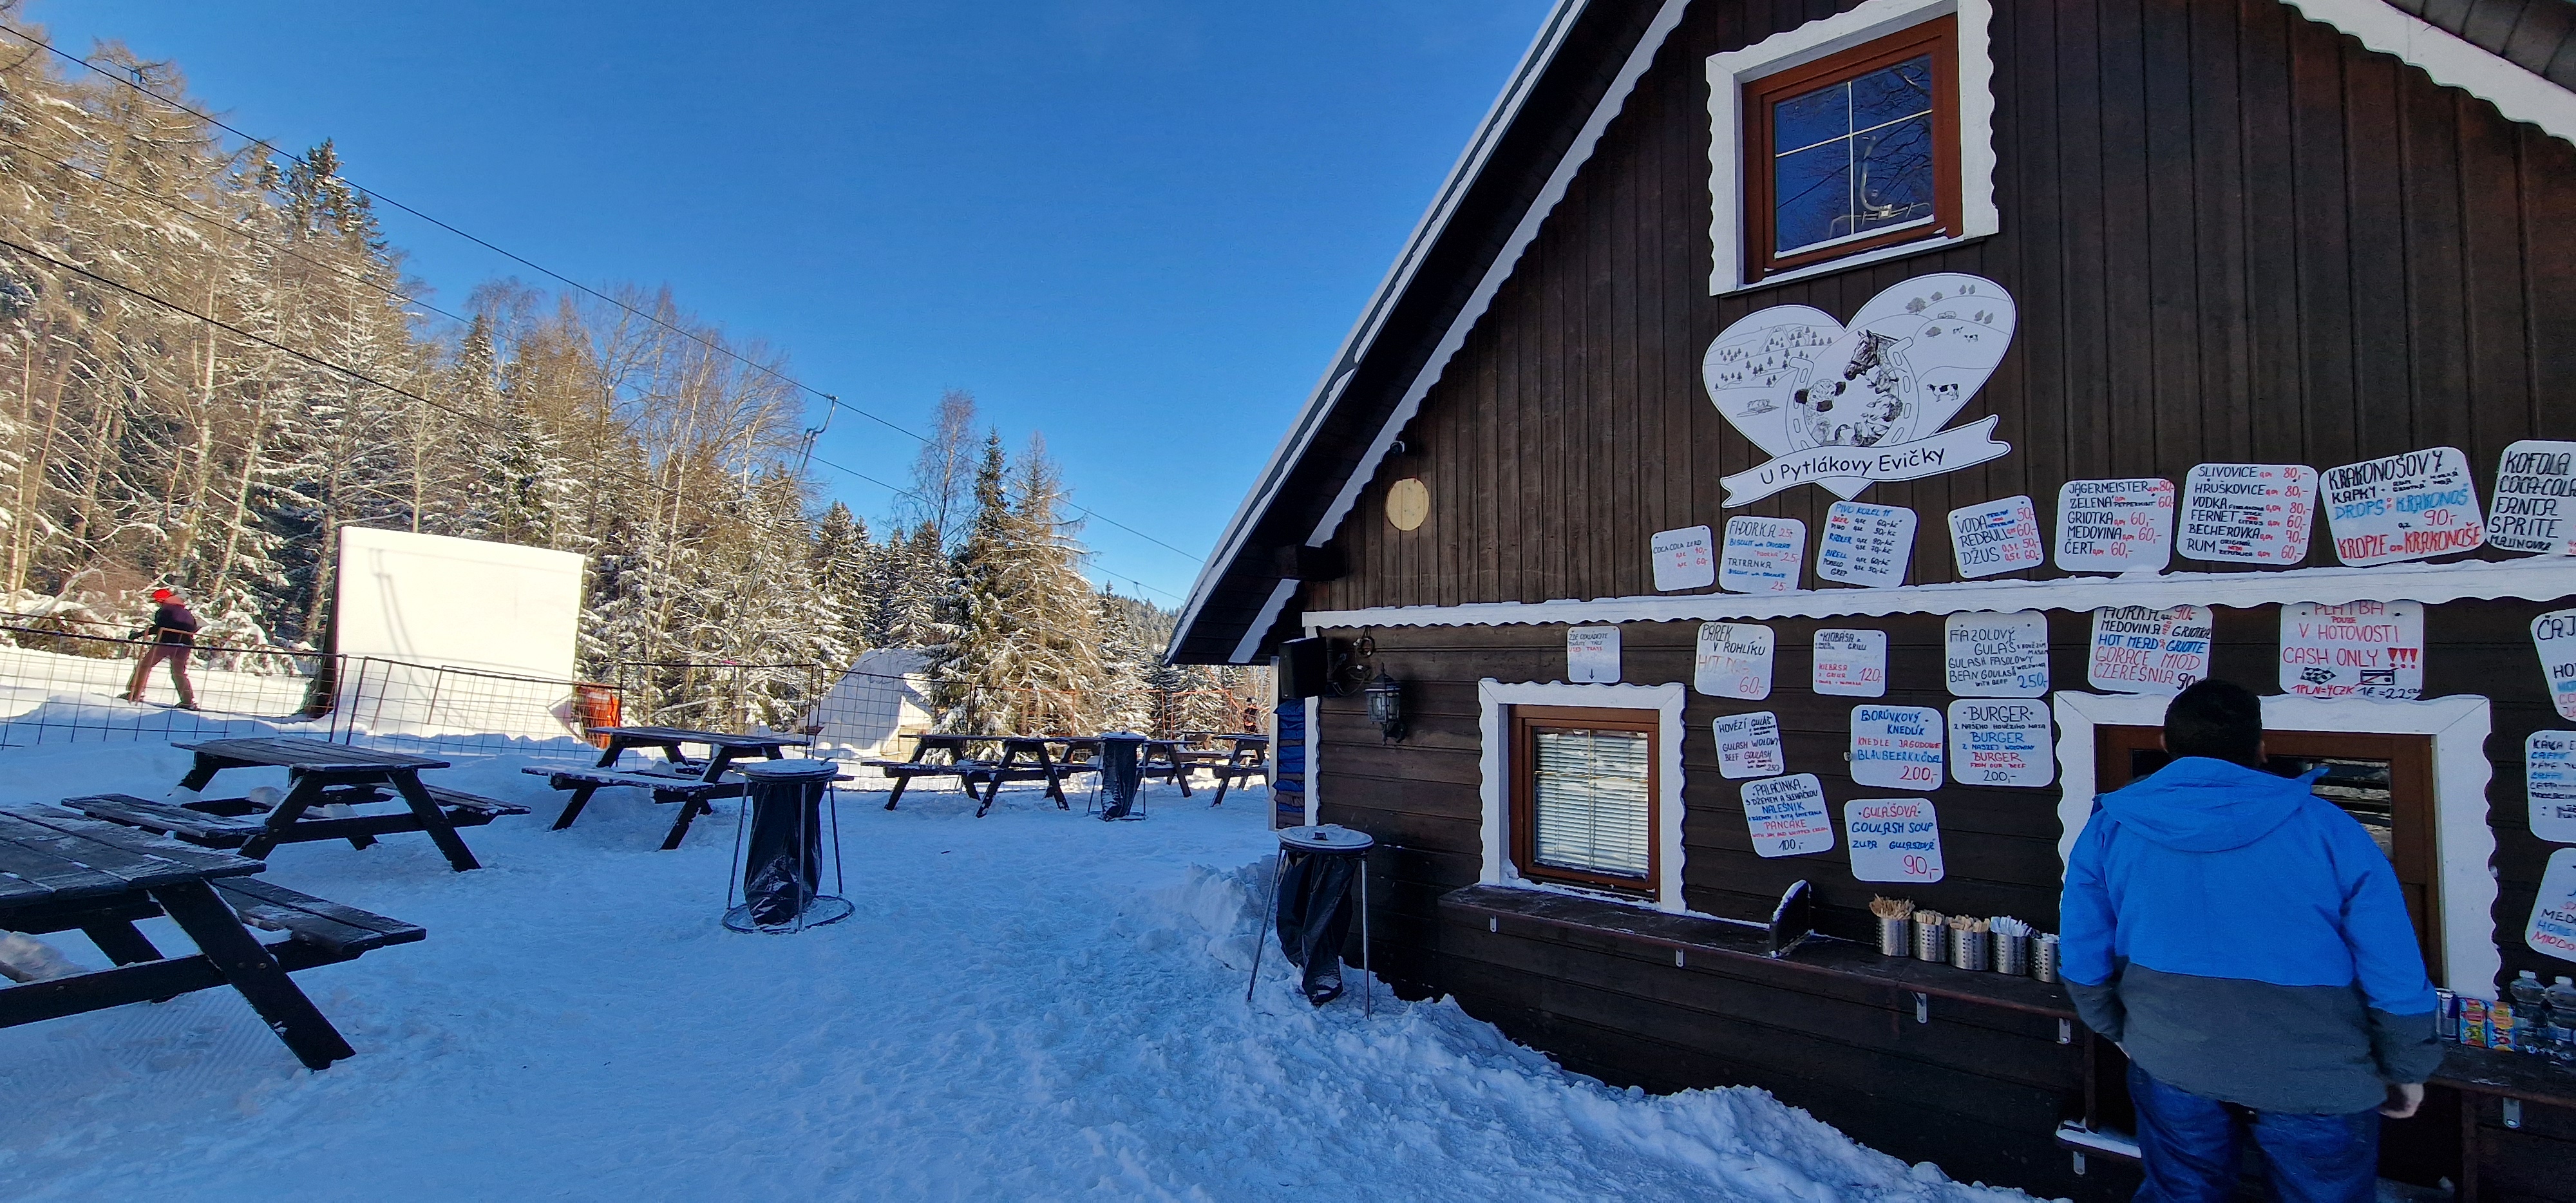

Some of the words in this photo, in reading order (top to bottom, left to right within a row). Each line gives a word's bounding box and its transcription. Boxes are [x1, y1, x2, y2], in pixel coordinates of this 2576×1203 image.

[1760, 469, 1774, 484] U
[1780, 455, 1873, 482] Pytlákovy
[1879, 448, 1945, 472] Evičky
[2505, 451, 2571, 475] KOFOLA
[2198, 466, 2258, 477] SLIVOVICE
[2069, 481, 2148, 494] JÄGERMEISTER
[2195, 480, 2266, 495] HRUŠKOVICE
[2070, 496, 2114, 509] ZELENÁ
[2332, 487, 2376, 504] KAPKY
[1836, 504, 1854, 514] PIVO
[1857, 507, 1880, 516] KOZEL
[2193, 497, 2228, 509] VODKA
[2334, 500, 2384, 520] DROPS
[2495, 497, 2558, 515] FANTA
[2067, 511, 2113, 525] GRIOTKA
[2191, 509, 2240, 522] FERNET
[1729, 520, 1776, 538] FIDORKA
[1956, 515, 1987, 533] VODA
[2490, 516, 2562, 538] SPRITE
[1958, 528, 2014, 547] REDBULL
[2067, 526, 2121, 540] MEDOVINA
[2188, 524, 2260, 539] BECHEROVKA
[2065, 539, 2094, 554] ČERT
[2186, 538, 2215, 553] RUM
[1962, 547, 2000, 565] DŽUS
[2101, 620, 2161, 635] MEDOVINA
[2299, 623, 2309, 638] V
[2318, 624, 2399, 643] HOTOVOSTI
[2098, 634, 2124, 646] HOT
[1714, 642, 1718, 652] V
[1723, 641, 1766, 656] ROHLÍKU
[1949, 657, 1985, 668] GULASH
[2283, 647, 2329, 664] CASH
[2336, 649, 2378, 667] ONLY
[1949, 670, 1978, 683] BEAN
[1967, 706, 2031, 723] BURGER
[1888, 725, 1924, 735] KNEDLÍK
[1857, 736, 1889, 746] KNEDLE
[1970, 732, 2025, 743] BURGER
[1723, 741, 1748, 752] GULASH
[1744, 750, 1772, 759] GOULASH
[1972, 752, 2022, 762] BURGER
[1764, 819, 1807, 829] PANCAKE
[1852, 822, 1904, 835] GOULASH
[1909, 822, 1933, 833] SOUP
[1852, 840, 1877, 849] ZUPA
